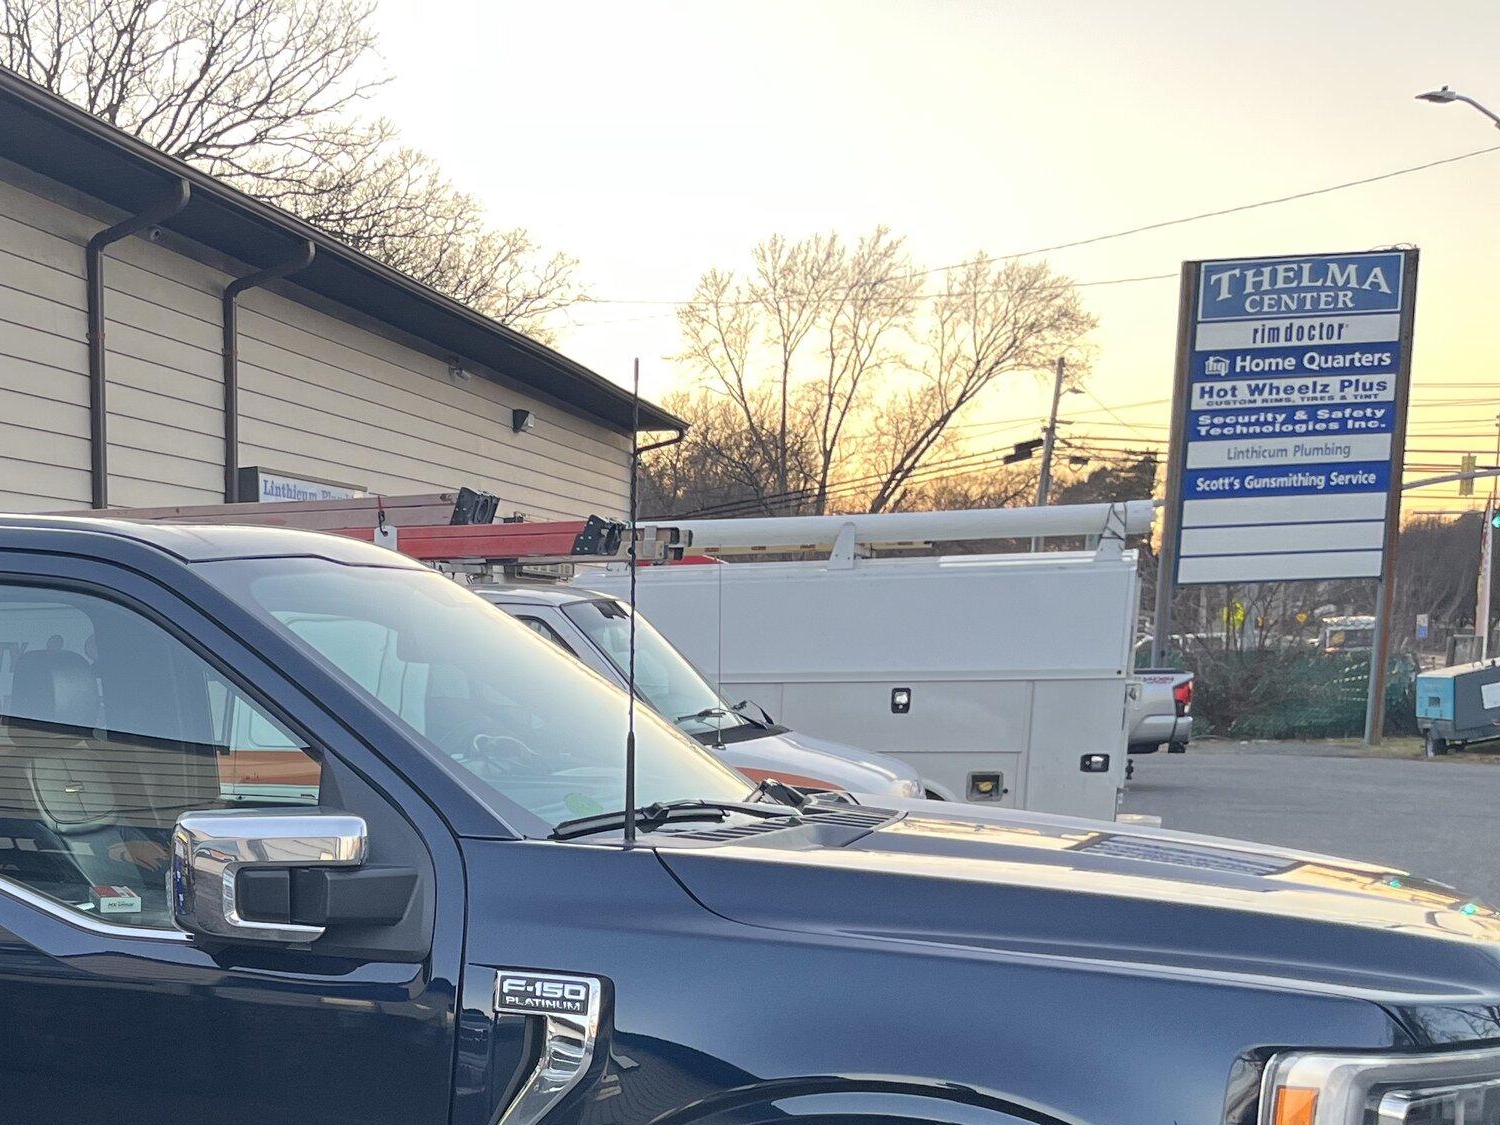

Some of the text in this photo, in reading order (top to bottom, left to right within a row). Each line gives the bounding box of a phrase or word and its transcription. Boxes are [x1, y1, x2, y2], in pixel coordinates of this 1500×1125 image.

[1210, 262, 1392, 301] THELMA
[1244, 291, 1355, 313] CENTER
[1235, 355, 1296, 373] Home
[1303, 350, 1392, 370] Quarters
[1199, 378, 1388, 400] Hot Wheelz Plus
[1206, 398, 1258, 407] CUSTOM
[1300, 395, 1335, 403] TIRES
[1353, 393, 1379, 401] TINT
[1196, 419, 1386, 436] Technologies Inc.
[1197, 407, 1386, 426] Security & Safety
[1227, 443, 1351, 461] Linthicum Plumbing
[263, 479, 317, 501] Linthicum
[1195, 469, 1376, 492] Scott's Gunsmithing Service
[502, 978, 587, 1000] F-150
[505, 996, 581, 1011] PLATINUM
